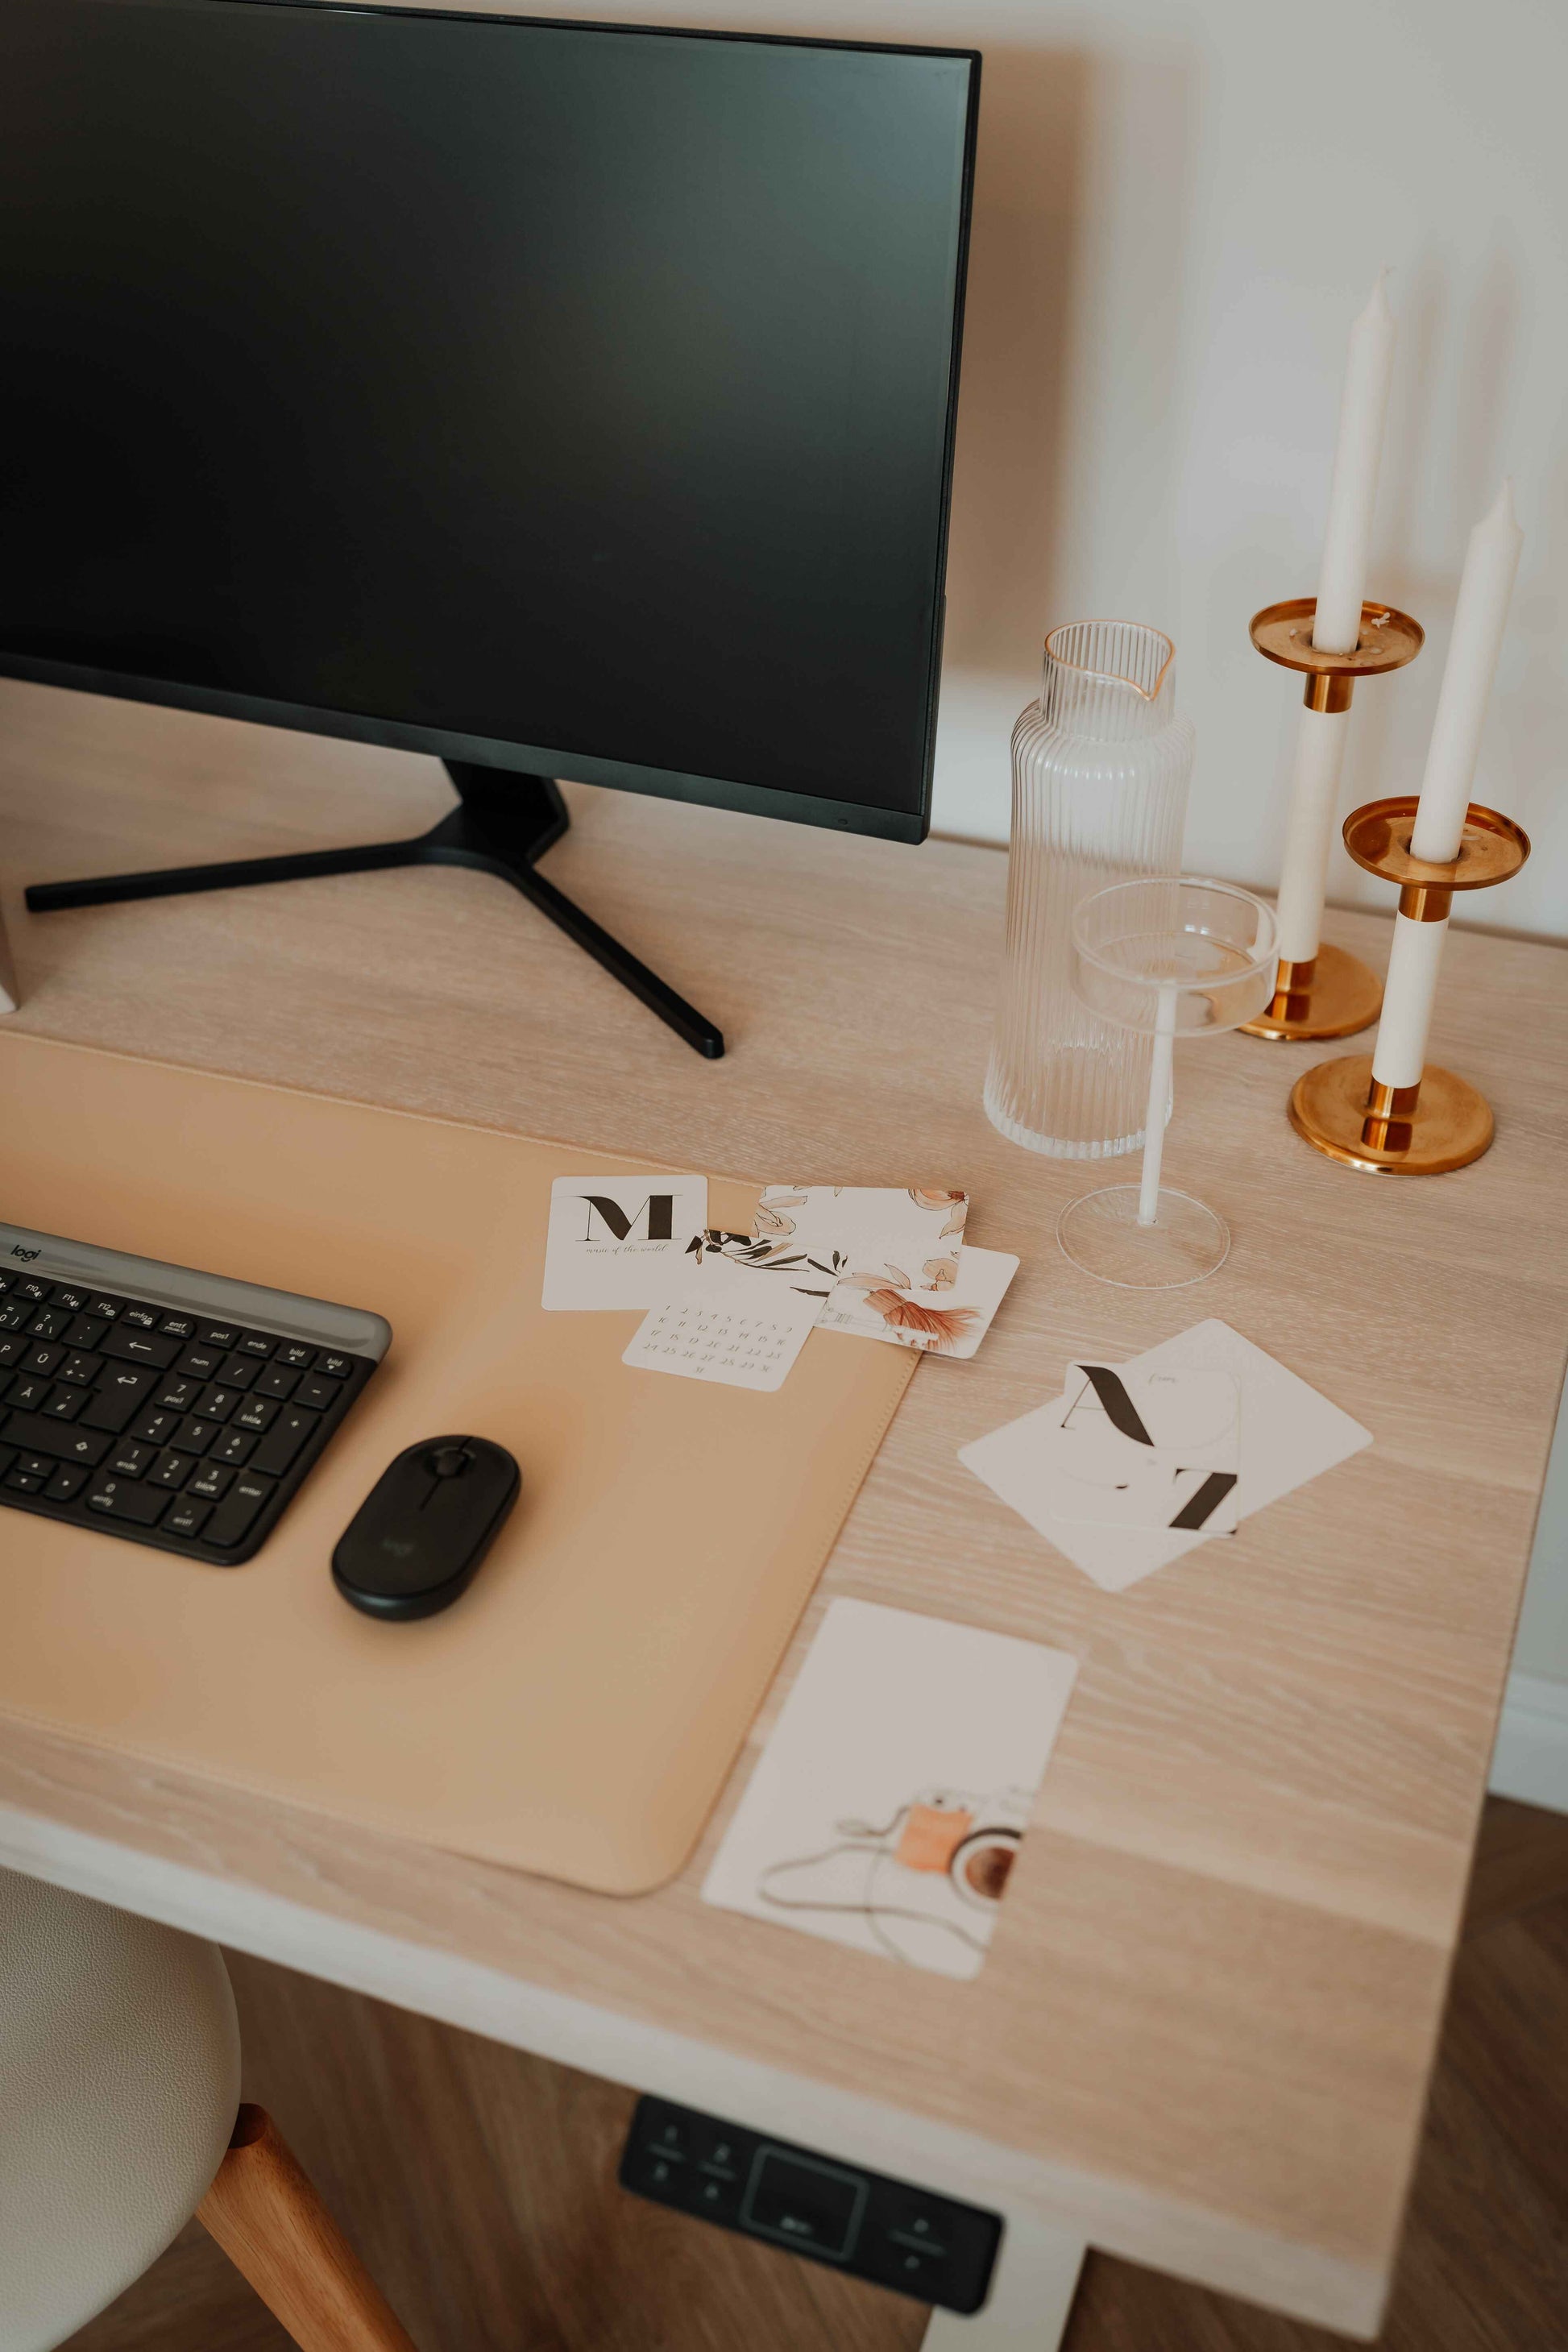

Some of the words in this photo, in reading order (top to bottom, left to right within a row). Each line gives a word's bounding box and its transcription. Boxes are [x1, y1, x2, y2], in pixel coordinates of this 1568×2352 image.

[558, 1195, 683, 1242] M
[10, 1245, 42, 1262] logi
[612, 1246, 620, 1255] of
[26, 1284, 39, 1292] F10
[62, 1293, 75, 1301] F11
[97, 1302, 111, 1311] F12
[129, 1311, 148, 1321] einfg
[168, 1321, 188, 1329] entf
[696, 1324, 708, 1333] 12
[209, 1332, 230, 1340] pos1
[1, 1344, 10, 1353] P
[247, 1341, 267, 1350] ende
[288, 1348, 305, 1357] bild
[746, 1348, 761, 1356] 22
[37, 1353, 48, 1363] Ü
[190, 1357, 209, 1367] num
[20, 1387, 33, 1398] Ä
[177, 1384, 186, 1392] 7
[215, 1394, 225, 1403] 8
[255, 1404, 264, 1413] 9
[1060, 1365, 1155, 1447] A
[192, 1426, 202, 1436] 5
[231, 1437, 241, 1446] 6
[132, 1450, 139, 1458] 1
[168, 1459, 179, 1470] 2
[208, 1470, 219, 1480] 3
[105, 1483, 116, 1493] 0
